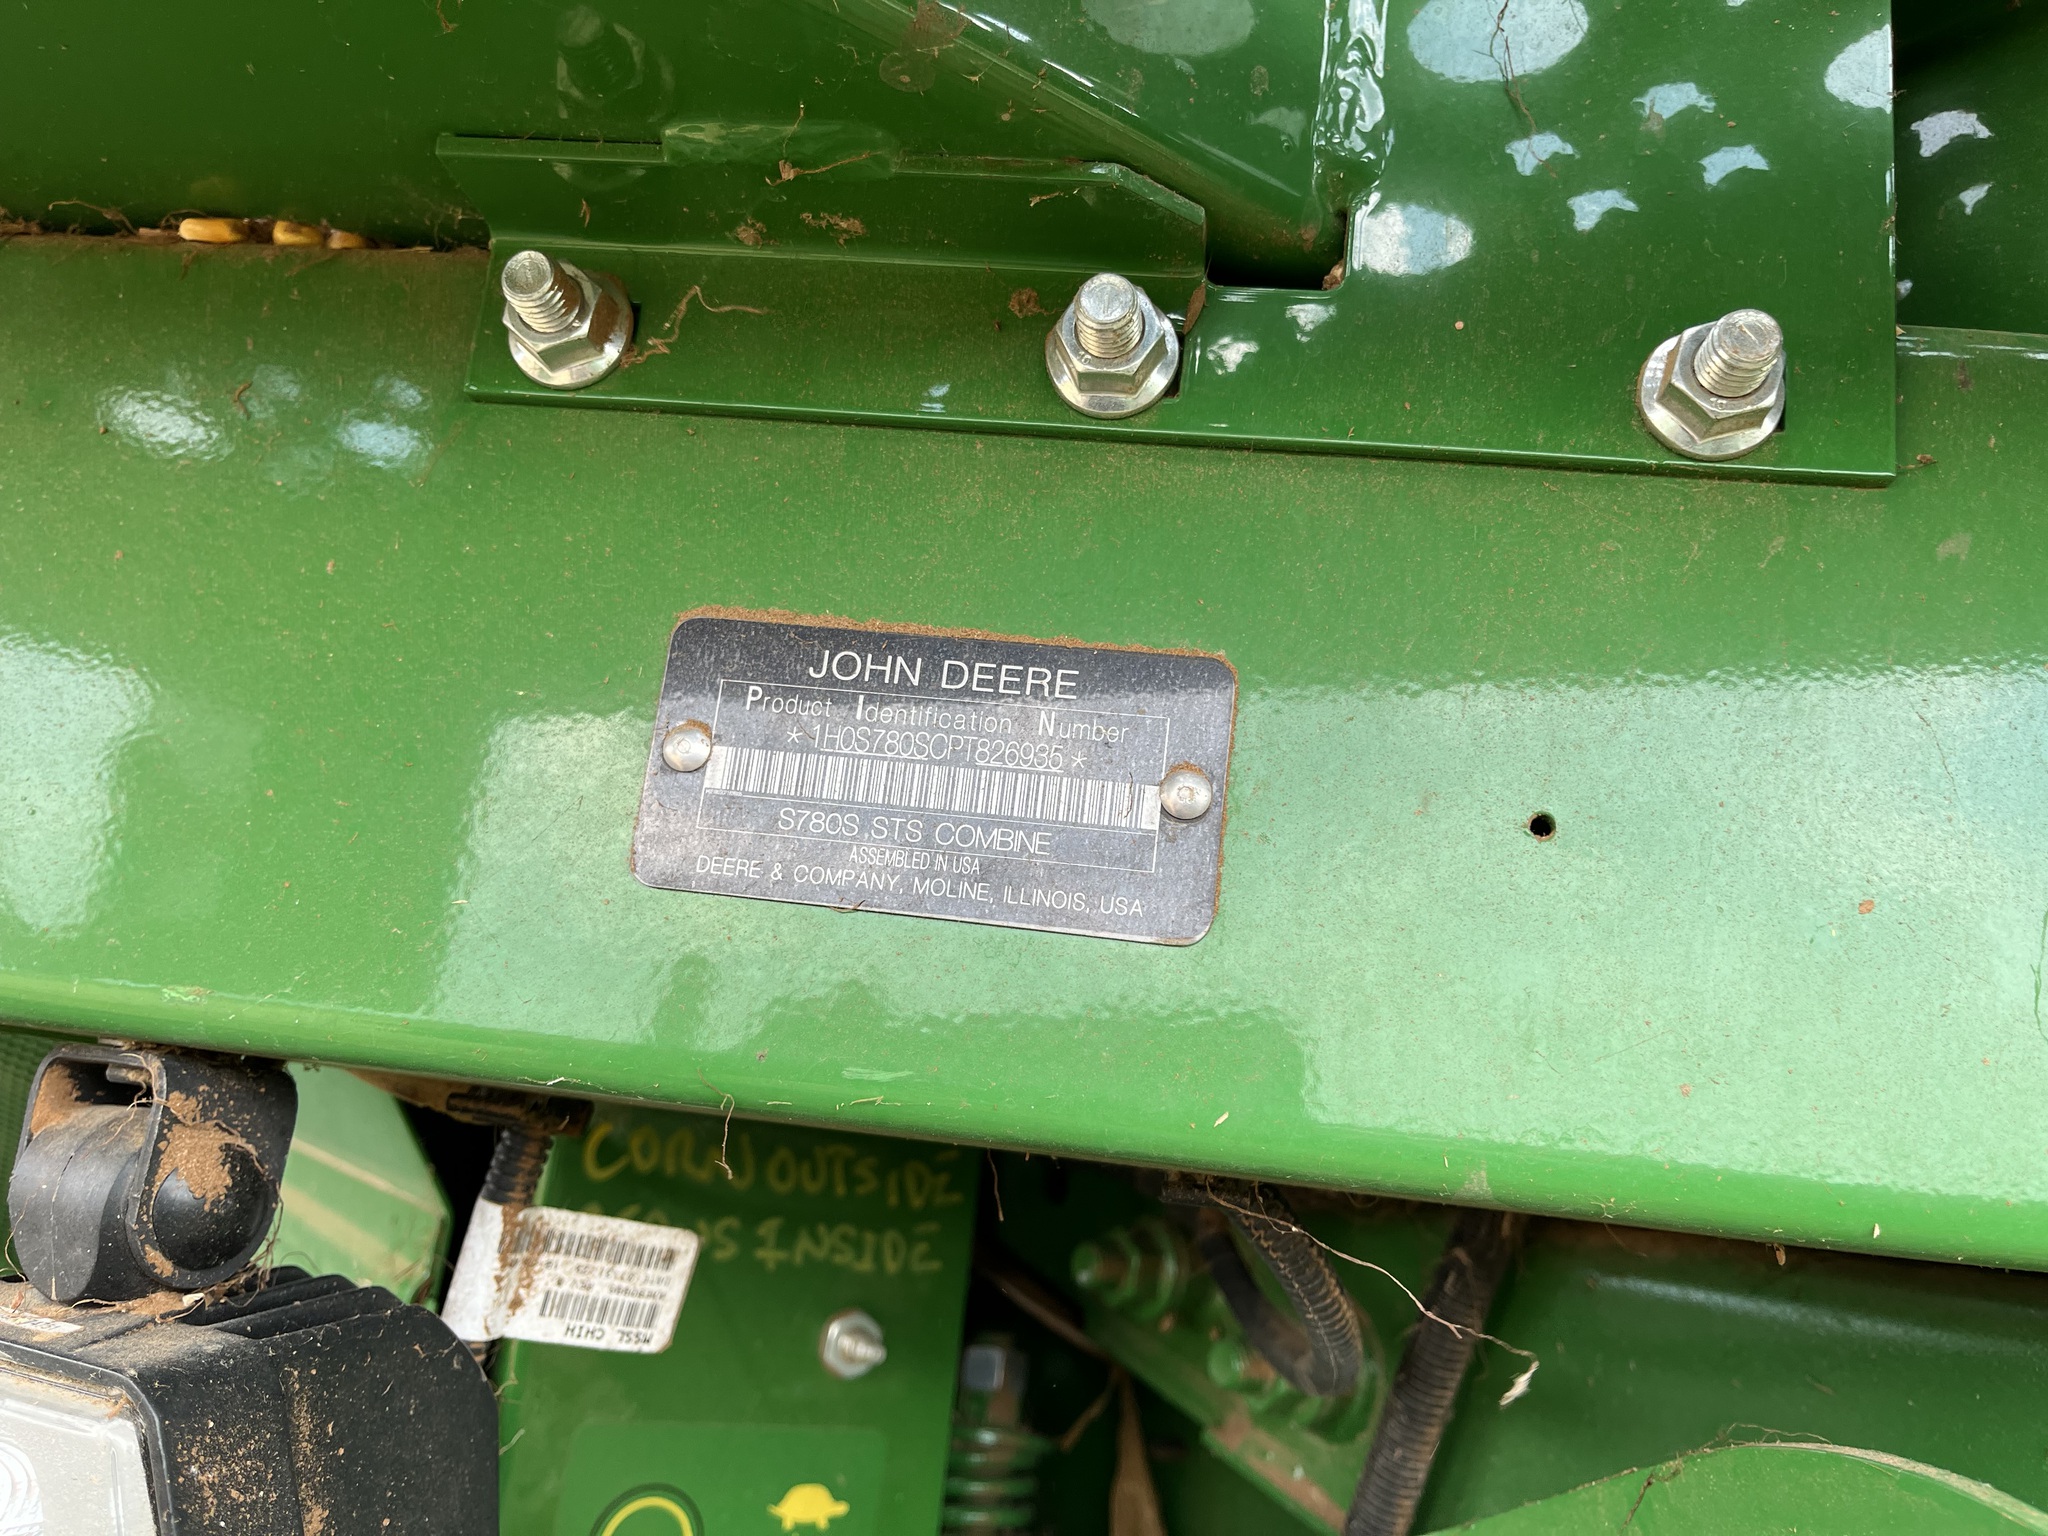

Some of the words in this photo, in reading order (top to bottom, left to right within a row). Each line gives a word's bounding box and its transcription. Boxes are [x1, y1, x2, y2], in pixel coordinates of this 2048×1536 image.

[809, 650, 922, 686] JOHN
[940, 659, 1080, 700] DEERE
[745, 685, 832, 718] Product
[855, 694, 1012, 734] Identification
[1038, 710, 1129, 743] Number
[778, 807, 860, 836] S780S
[871, 815, 923, 843] STS
[935, 822, 1053, 856] COMBINE
[696, 855, 762, 878] DEERE
[770, 862, 783, 881] &
[793, 864, 904, 894] COMPANY,
[912, 877, 993, 904] MOLINE,
[1003, 885, 1090, 914] ILLINOIS,
[1100, 895, 1144, 917] USA
[849, 845, 931, 870] ASSEMBLED
[934, 853, 949, 872] IN
[952, 855, 980, 875] USA
[583, 1122, 756, 1191] CORN
[765, 1142, 964, 1210] OUTSIDE
